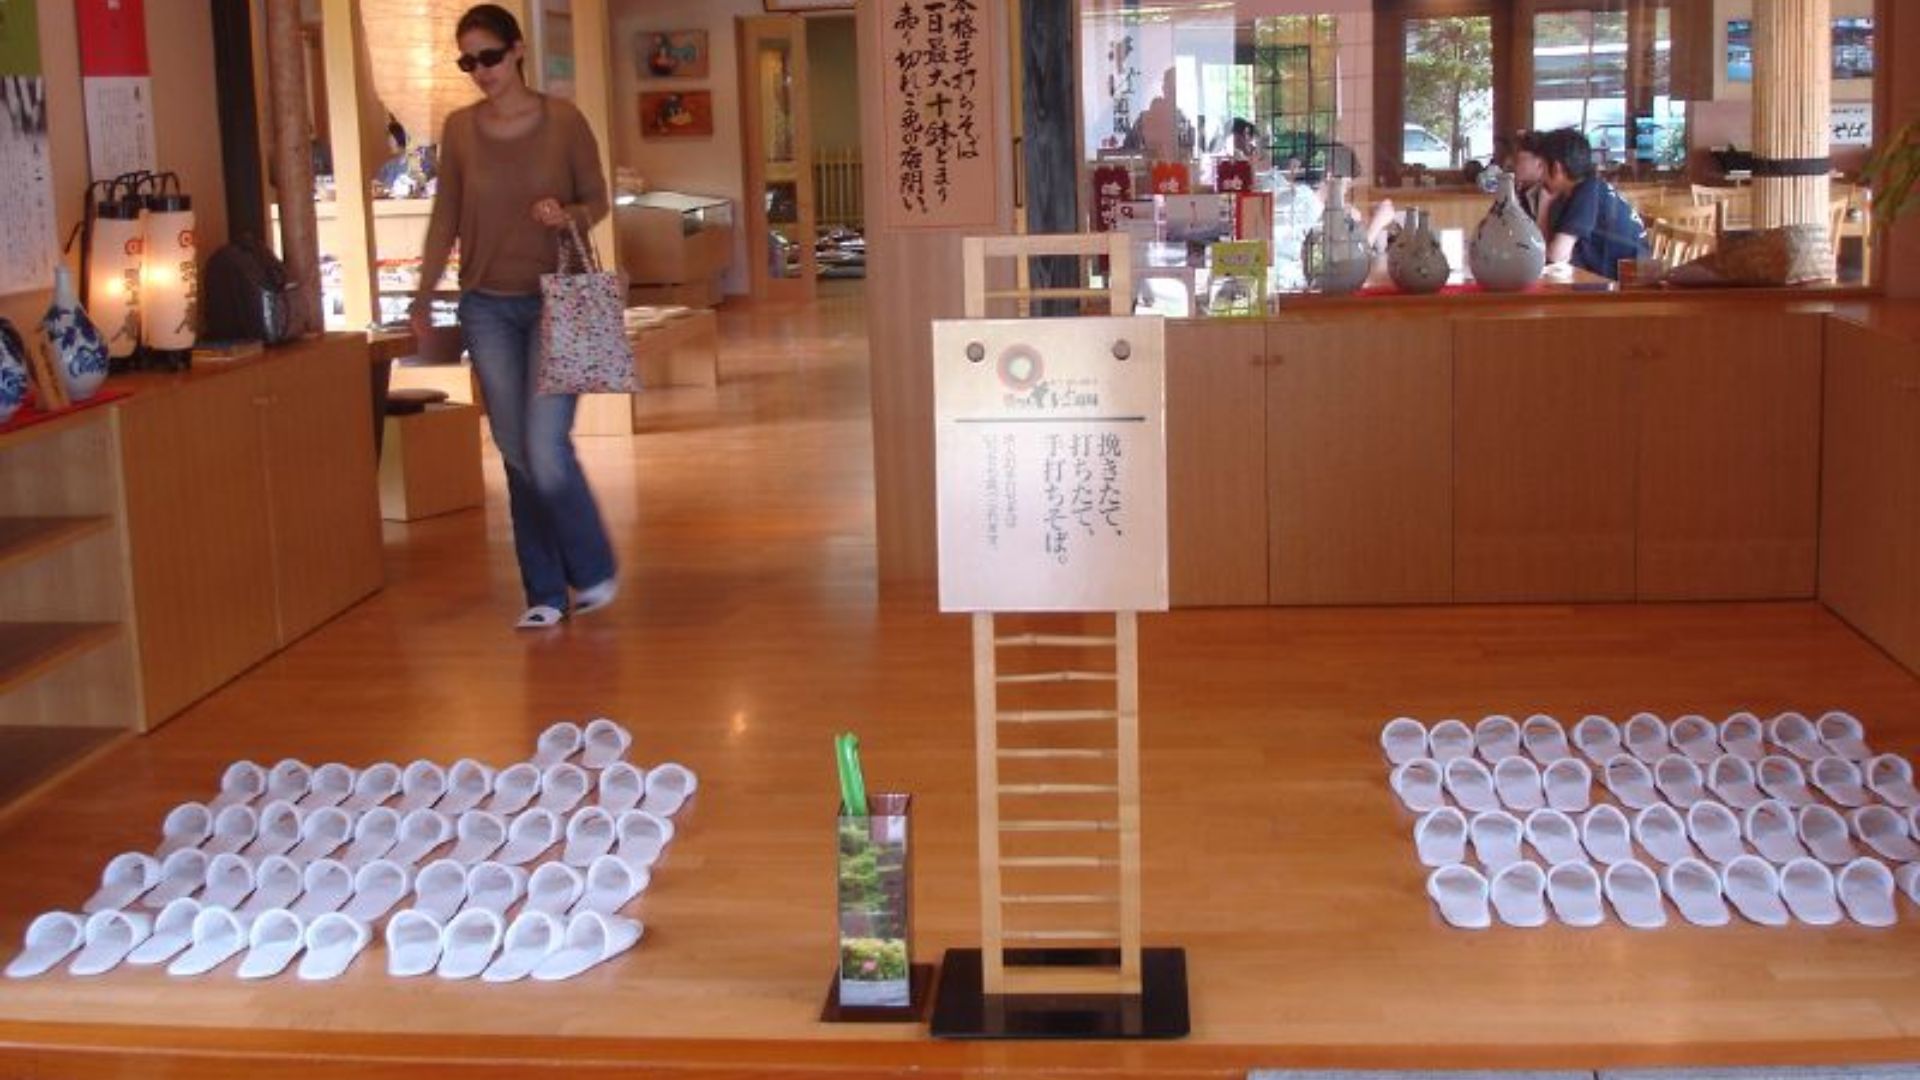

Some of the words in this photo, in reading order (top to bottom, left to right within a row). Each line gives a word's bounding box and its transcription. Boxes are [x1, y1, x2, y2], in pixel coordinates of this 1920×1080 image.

[1070, 433, 1095, 536] 打ちたて、
[1097, 432, 1122, 536] 挽きたて、
